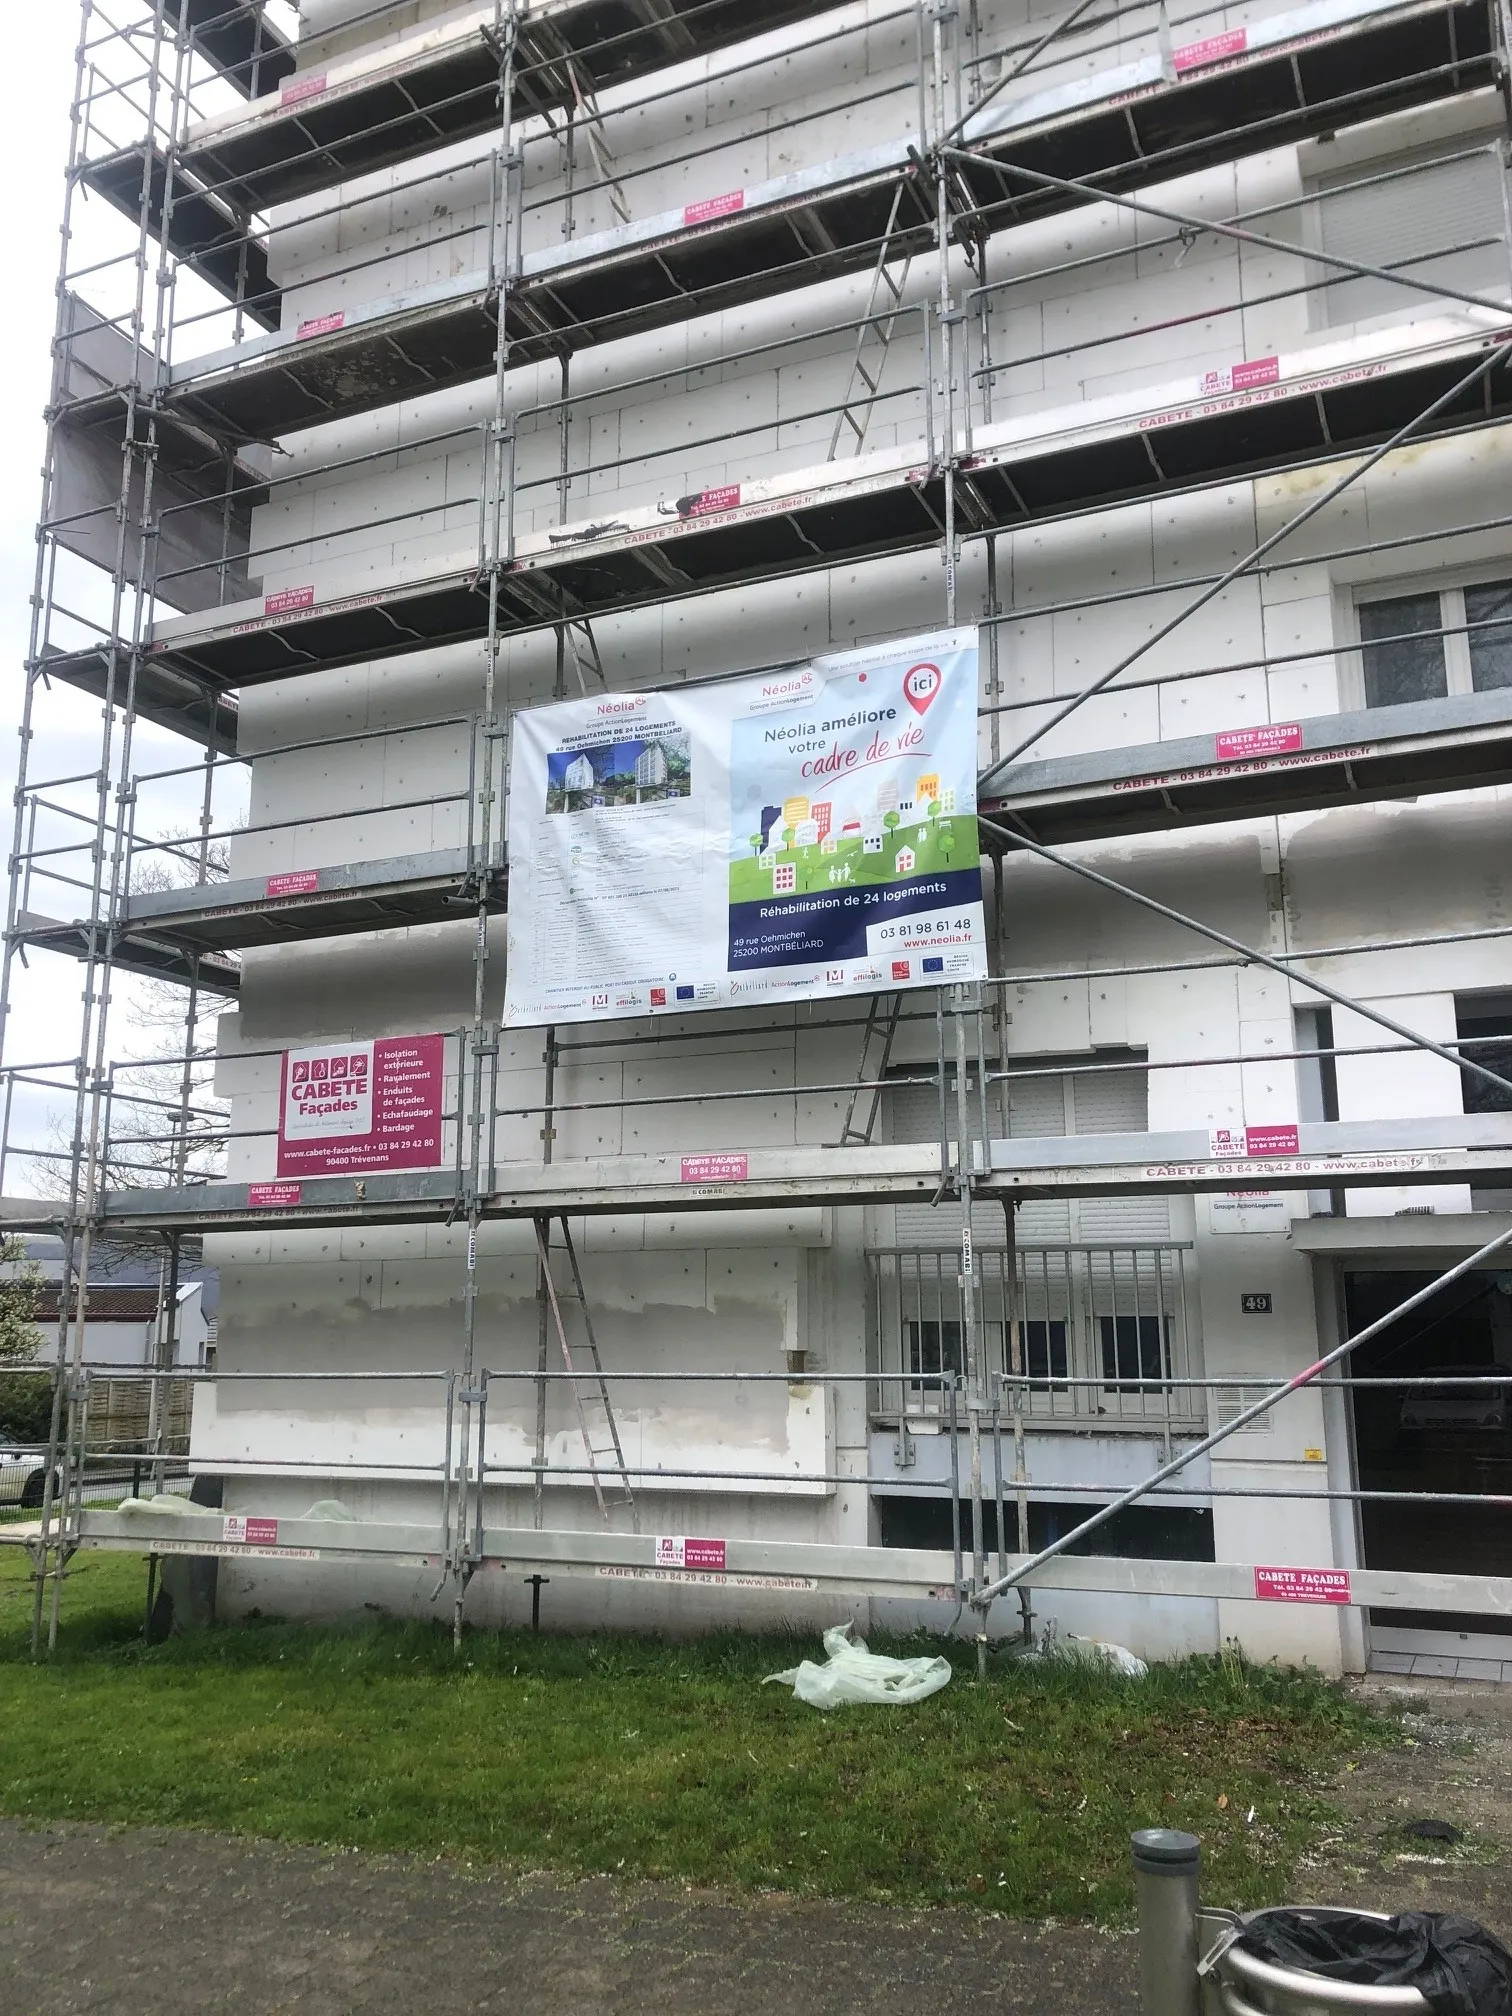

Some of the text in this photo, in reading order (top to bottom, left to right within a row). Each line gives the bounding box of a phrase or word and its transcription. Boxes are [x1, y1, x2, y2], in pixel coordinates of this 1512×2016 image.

[1138, 409, 1193, 429] CABETE
[1203, 404, 1217, 414] 03
[1221, 400, 1234, 411] 84
[1238, 396, 1252, 407] 29
[1256, 392, 1269, 403] 42
[1274, 388, 1288, 398] 80
[709, 487, 738, 500] FAÇADES
[624, 495, 812, 544] CABETE 03 84 29 42 80 www.cabete.fr
[233, 621, 266, 634] CABETE
[314, 608, 323, 616] 80
[329, 595, 383, 612] www.cabete.fr
[762, 681, 801, 696] Néolia
[914, 674, 932, 692] ici
[597, 702, 635, 715] Néolia
[749, 694, 814, 711] Groupe ActionLogement
[562, 730, 612, 744] REHABILITATION
[635, 721, 676, 732] LOGEMENTS
[764, 707, 897, 743] Néolia améliore
[1220, 726, 1298, 746] CABETE FAÇADES
[789, 739, 826, 754] votre
[802, 722, 925, 778] cadre de vie
[1113, 747, 1371, 791] CABETE 03 84 29 42 80 www.cabete.fr
[270, 878, 290, 886] CABETE
[205, 908, 238, 917] CABETE
[304, 891, 358, 904] www.cabete.fr
[760, 882, 947, 918] Réhabilitation de 24 logements
[880, 918, 971, 940] 03 81 98 61 48
[734, 930, 806, 947] 49 rue Oehmichen
[903, 933, 973, 948] www.neolia.fr
[733, 939, 824, 958] 25200 MONTBÉLIARD
[853, 972, 883, 982] effilogis
[384, 1049, 418, 1059] Isolation
[383, 1059, 423, 1069] extérieure
[383, 1072, 430, 1083] Ravalement
[292, 1078, 368, 1101] CABETE
[383, 1086, 412, 1096] Enduits
[299, 1099, 358, 1117] Façades
[383, 1096, 425, 1106] de façades
[383, 1109, 433, 1120] Echafaudage
[382, 1123, 415, 1133] Bardage
[284, 1139, 434, 1159] www.cabete-facades.fr 03 84 29 42 80
[1211, 1143, 1245, 1151] CABETE
[326, 1154, 389, 1165] 90400 Trévenans
[732, 1165, 740, 1173] 80
[1146, 1161, 1311, 1177] CABETE 03 84 29 42 80
[252, 1185, 299, 1194] CABETE FAÇADES
[1246, 1297, 1266, 1309] 49
[153, 1542, 188, 1550] CABETE
[258, 1549, 315, 1557] www.cabete.fr
[657, 1552, 683, 1560] CABETE
[655, 1572, 666, 1580] 03
[670, 1572, 682, 1581] 84
[685, 1574, 697, 1582] 29
[700, 1575, 712, 1583] 42
[715, 1576, 727, 1584] 80
[1259, 1572, 1345, 1586] CABETE FAÇADES
